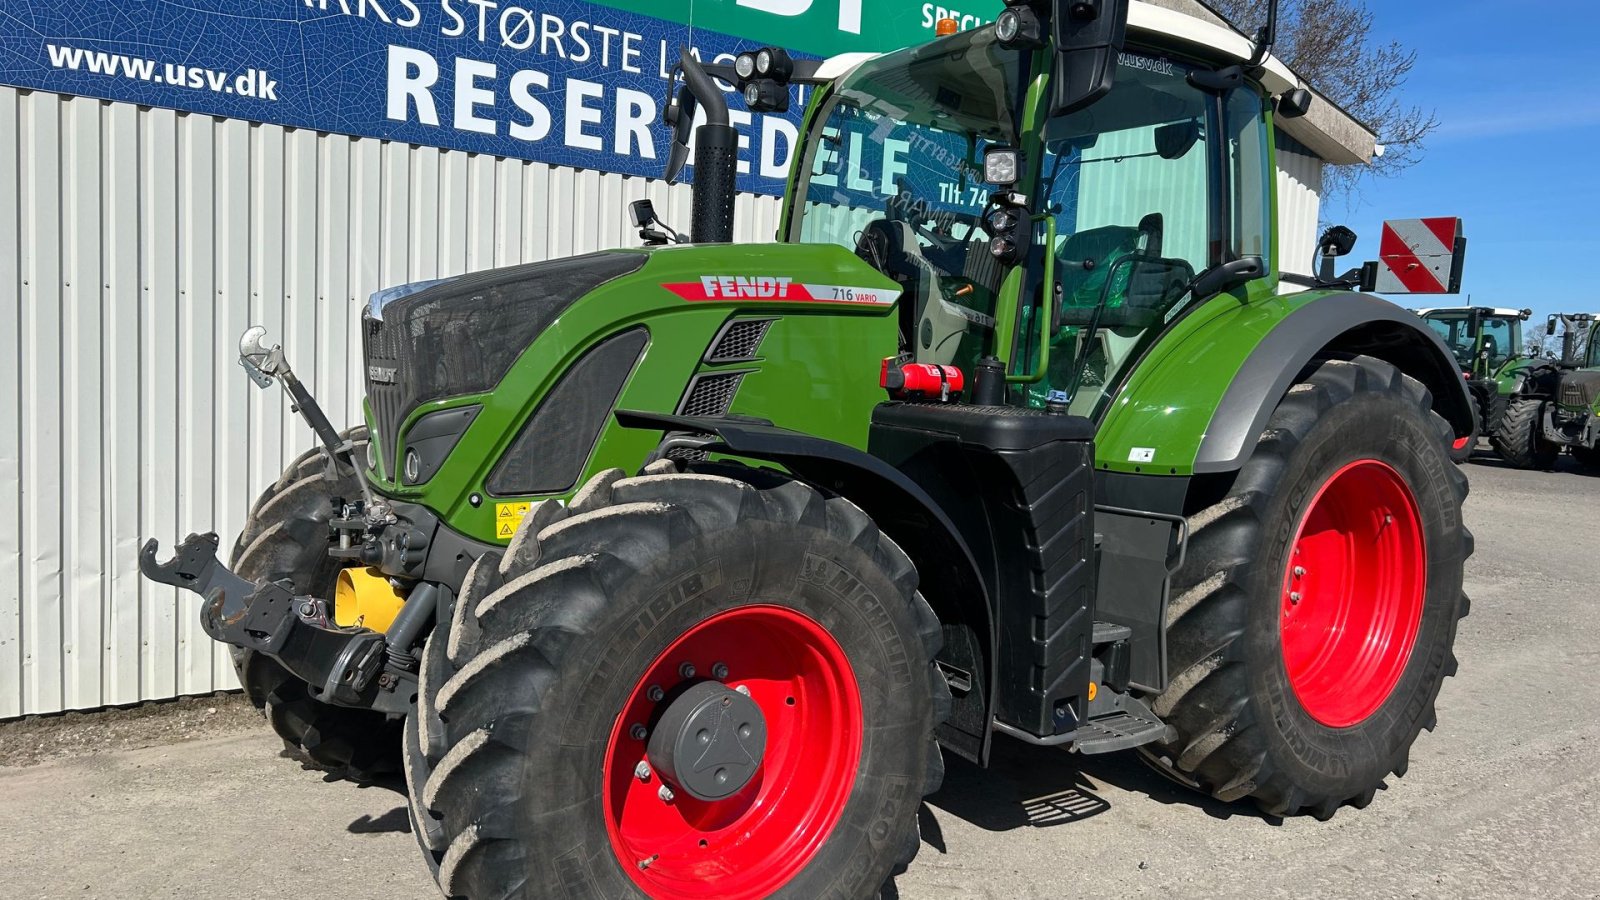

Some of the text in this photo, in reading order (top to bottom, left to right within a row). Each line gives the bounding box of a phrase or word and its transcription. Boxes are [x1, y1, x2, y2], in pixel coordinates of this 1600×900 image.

[441, 0, 643, 73] STØRSTE
[47, 44, 277, 101] www.usv.dk
[700, 276, 793, 298] FENDT
[832, 288, 877, 303] 716 VARIO
[828, 568, 911, 685] MICHELIN
